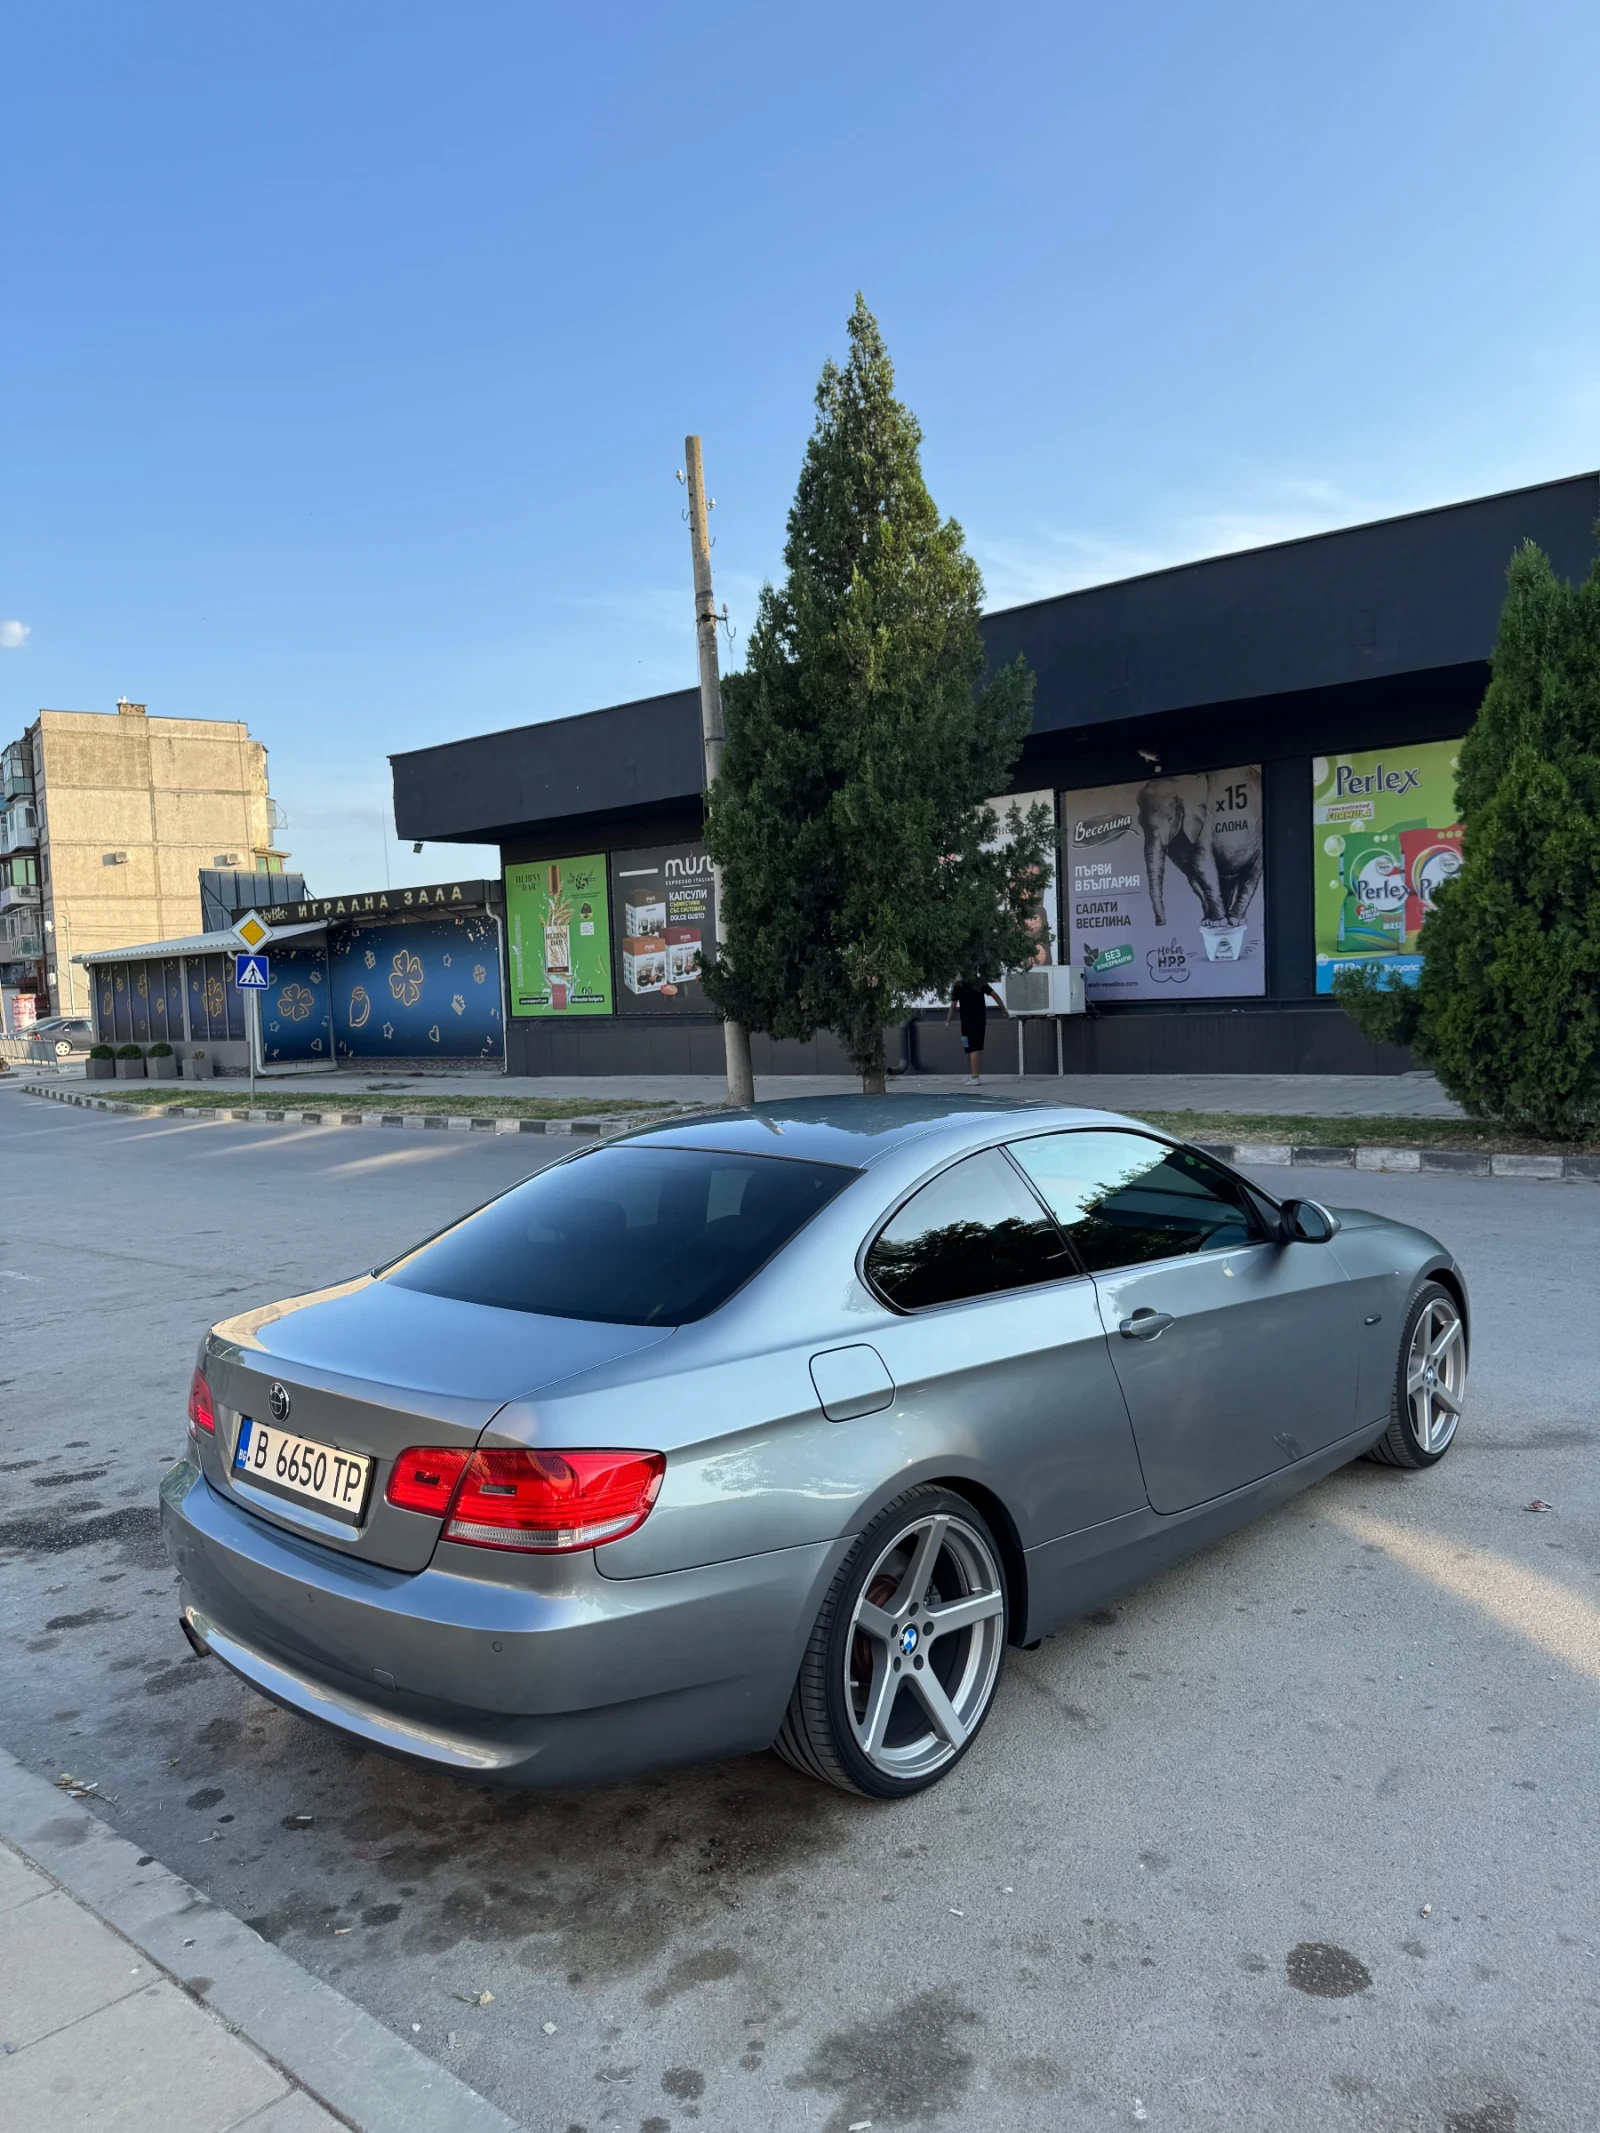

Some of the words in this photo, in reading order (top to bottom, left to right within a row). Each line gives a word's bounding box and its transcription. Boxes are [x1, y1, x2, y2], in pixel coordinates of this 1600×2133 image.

[1336, 763, 1420, 797] Perlex
[1215, 783, 1248, 813] x15
[1325, 809, 1372, 821] FORMULA
[1074, 815, 1132, 842] Веселина
[1215, 819, 1249, 834] СЛОНА
[1074, 863, 1112, 877] ПЪРВИ
[522, 882, 537, 892] DAR
[665, 878, 692, 886] ESPRESSO
[693, 876, 714, 884] ITALIAN
[1075, 880, 1083, 892] В
[1083, 874, 1141, 891] БЪЛГАРИЯ
[669, 889, 708, 902] КАПСУЛИ
[1358, 879, 1410, 900] Perlex
[298, 894, 389, 918] ИГРАЛНА
[403, 885, 463, 906] ЗАЛА
[1075, 901, 1118, 915] САЛАТИ
[669, 913, 687, 922] DOLCE
[687, 912, 705, 920] GUSTO
[1076, 914, 1132, 929] ВЕСЕЛИНА
[1382, 922, 1401, 930] WAS
[1104, 948, 1121, 962] БЕЗ
[254, 1431, 269, 1469] B
[276, 1439, 327, 1492] 6650
[332, 1457, 362, 1502] TP
